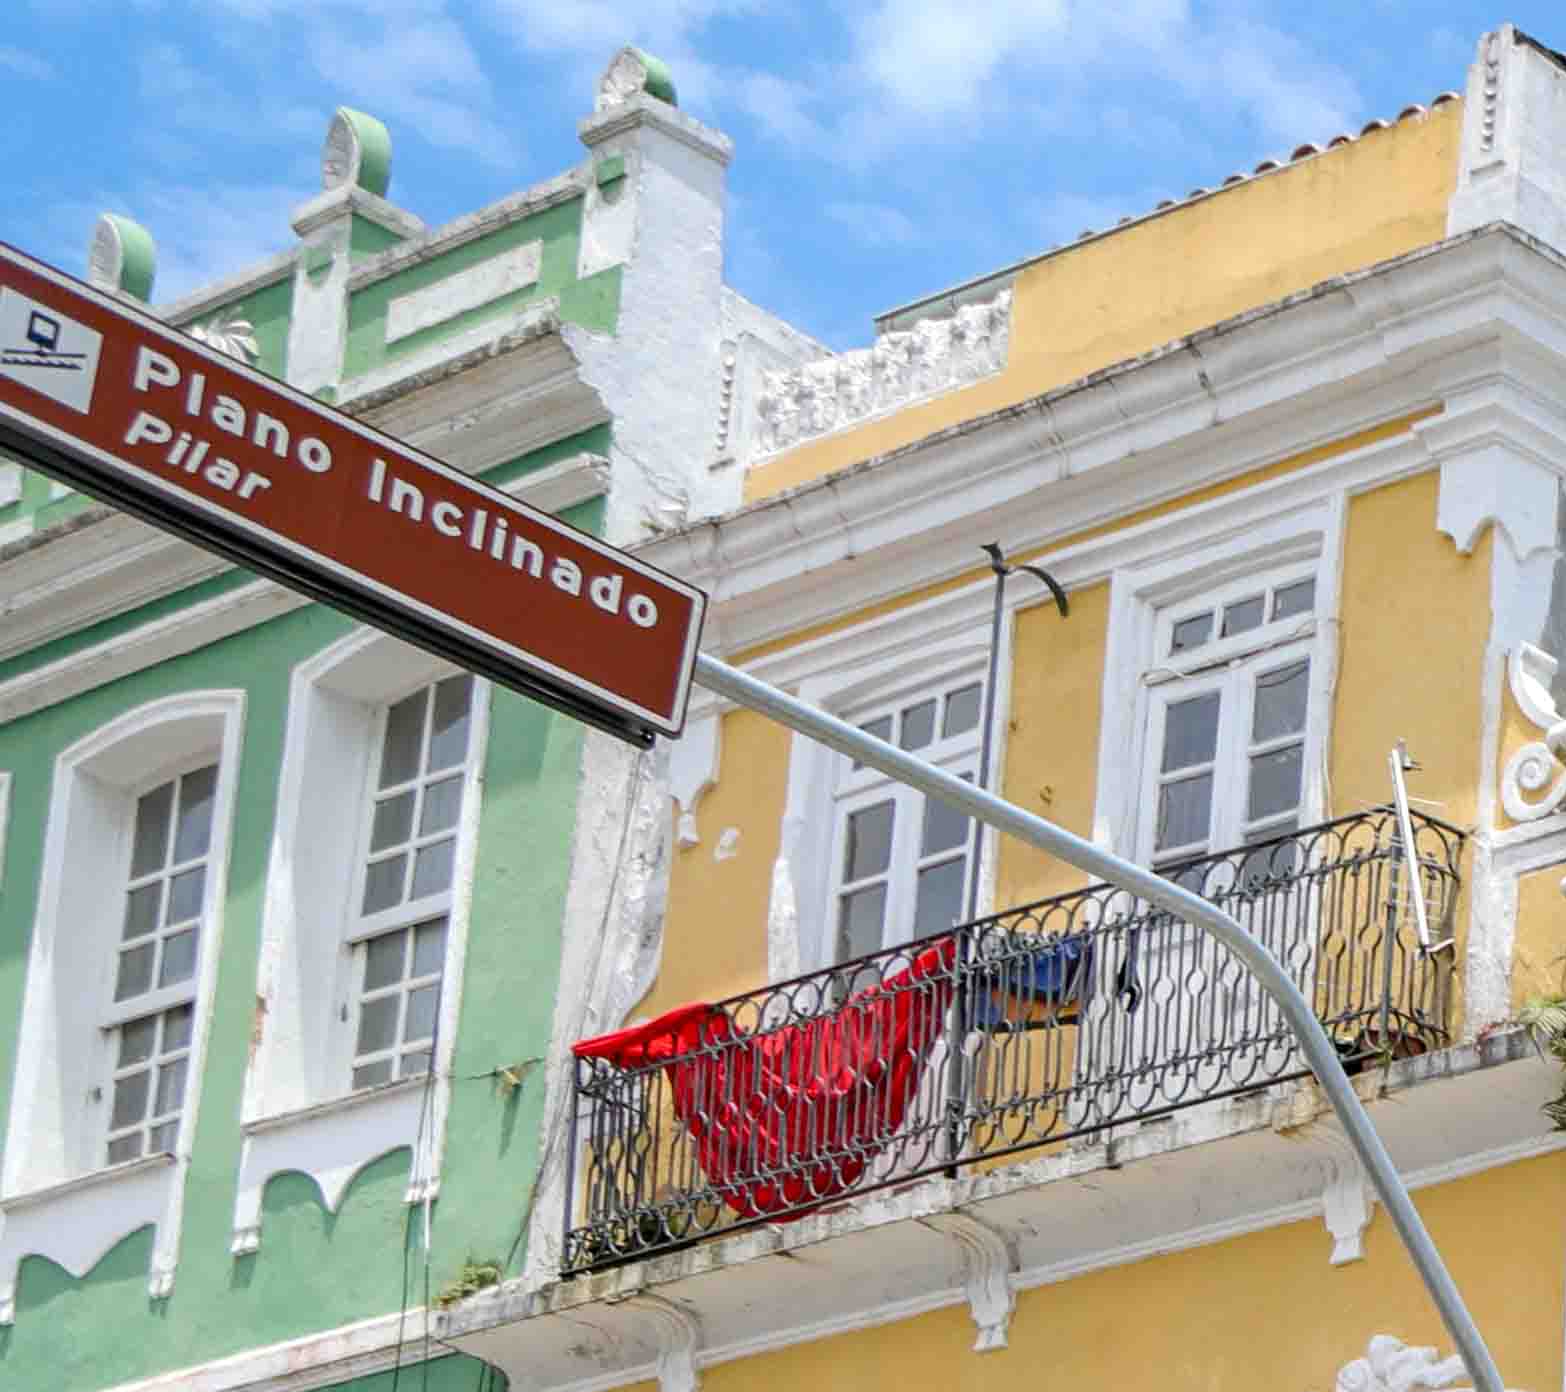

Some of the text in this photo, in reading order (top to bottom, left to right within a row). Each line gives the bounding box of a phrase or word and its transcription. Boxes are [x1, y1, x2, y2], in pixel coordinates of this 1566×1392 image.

[124, 411, 272, 498] Pilar
[134, 346, 658, 628] Plano Inclinado
